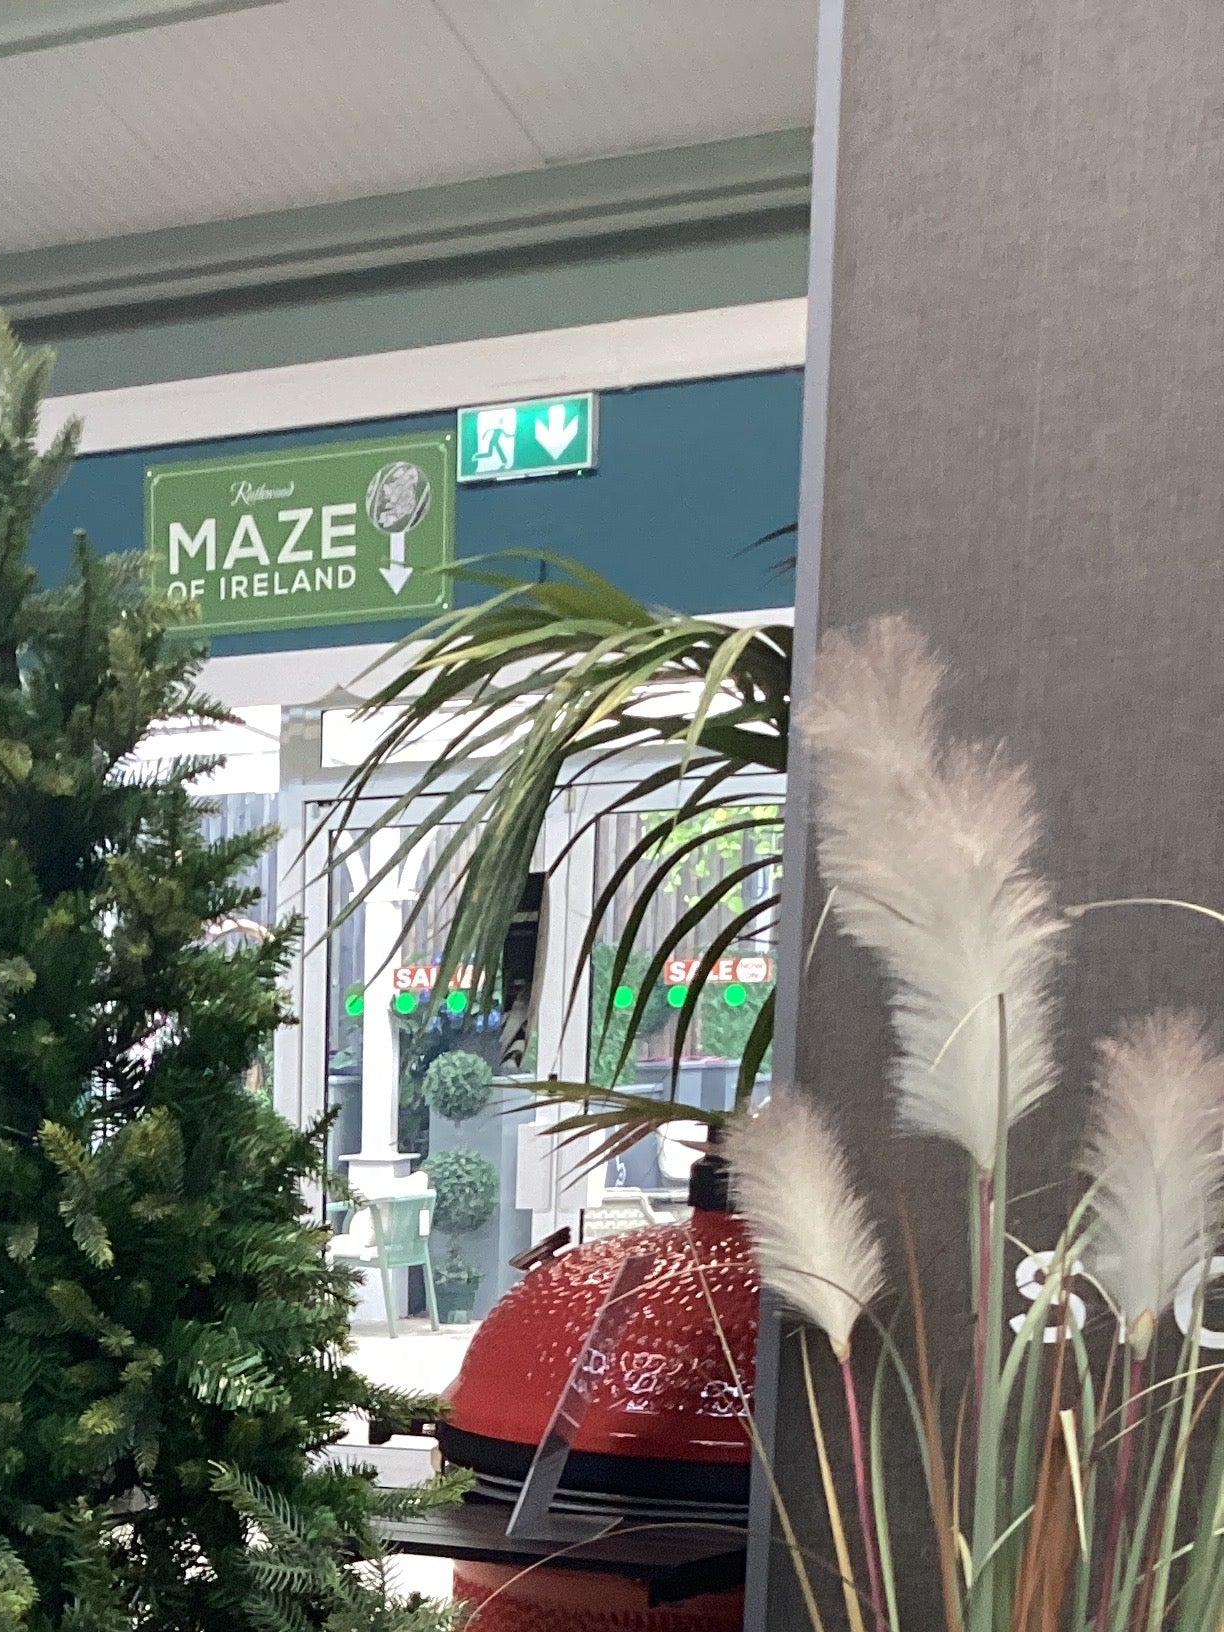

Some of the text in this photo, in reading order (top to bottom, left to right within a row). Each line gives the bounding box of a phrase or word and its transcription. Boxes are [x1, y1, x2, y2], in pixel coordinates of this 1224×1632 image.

[169, 502, 357, 575] MAZE
[167, 564, 357, 600] OF IRELAND
[396, 967, 455, 989] SAL
